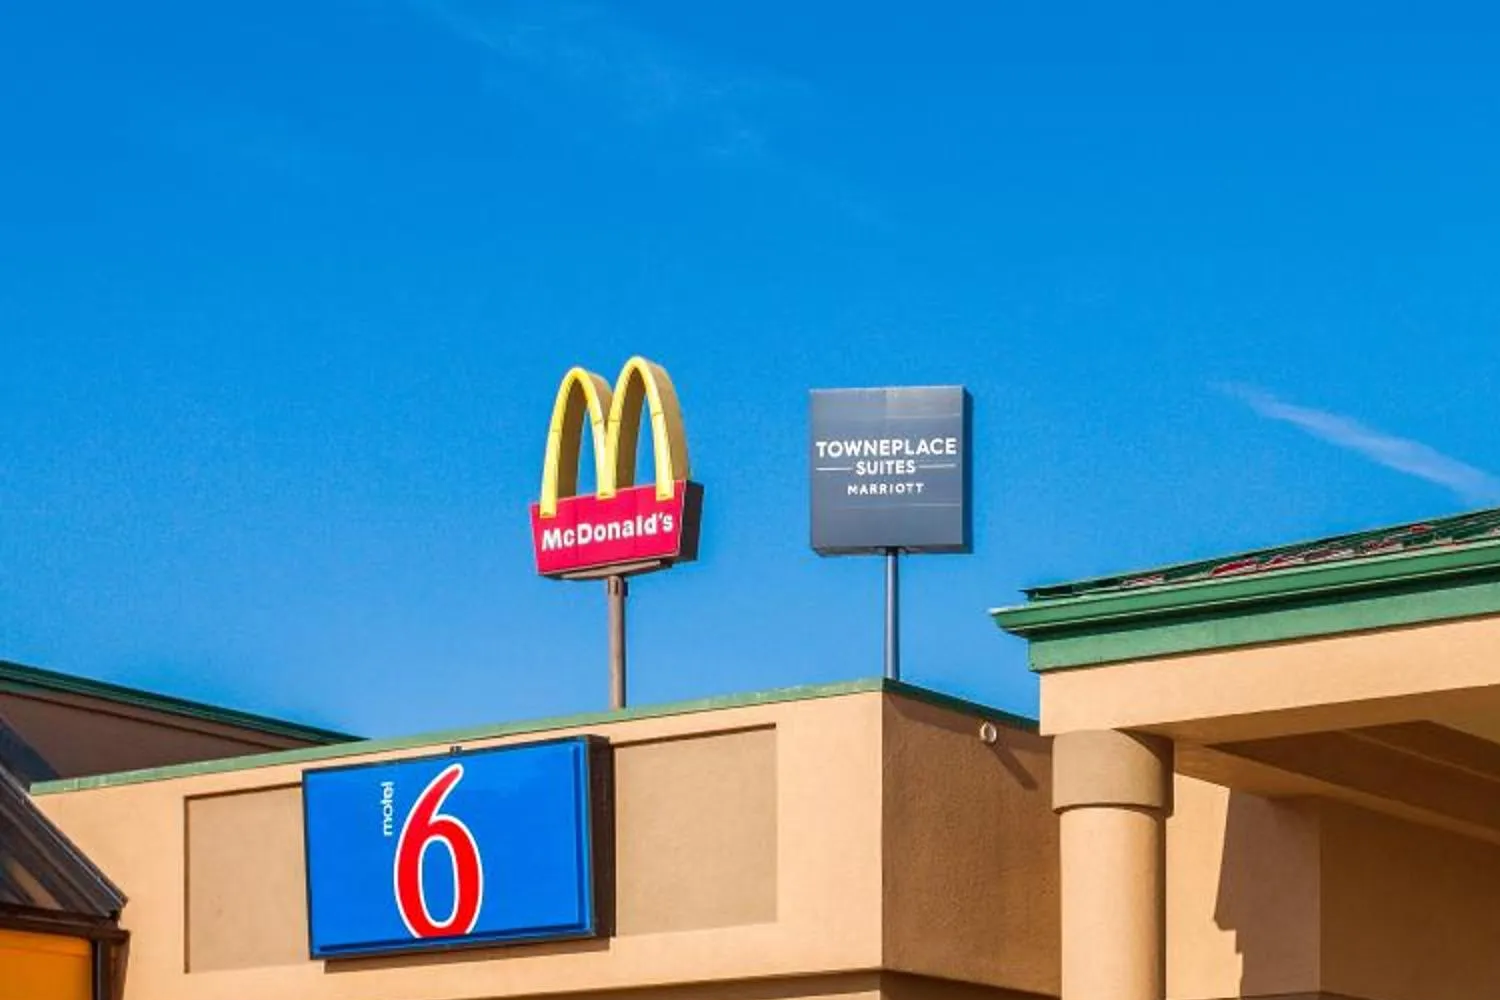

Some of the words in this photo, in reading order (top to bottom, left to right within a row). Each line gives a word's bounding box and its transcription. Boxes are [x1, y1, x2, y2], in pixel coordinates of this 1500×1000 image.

[815, 437, 958, 459] TOWNEPLACE
[855, 459, 917, 476] SUITES
[846, 482, 925, 496] MARRIOTT
[541, 511, 673, 551] McDonald's
[379, 780, 395, 837] motel
[393, 763, 484, 939] 6
